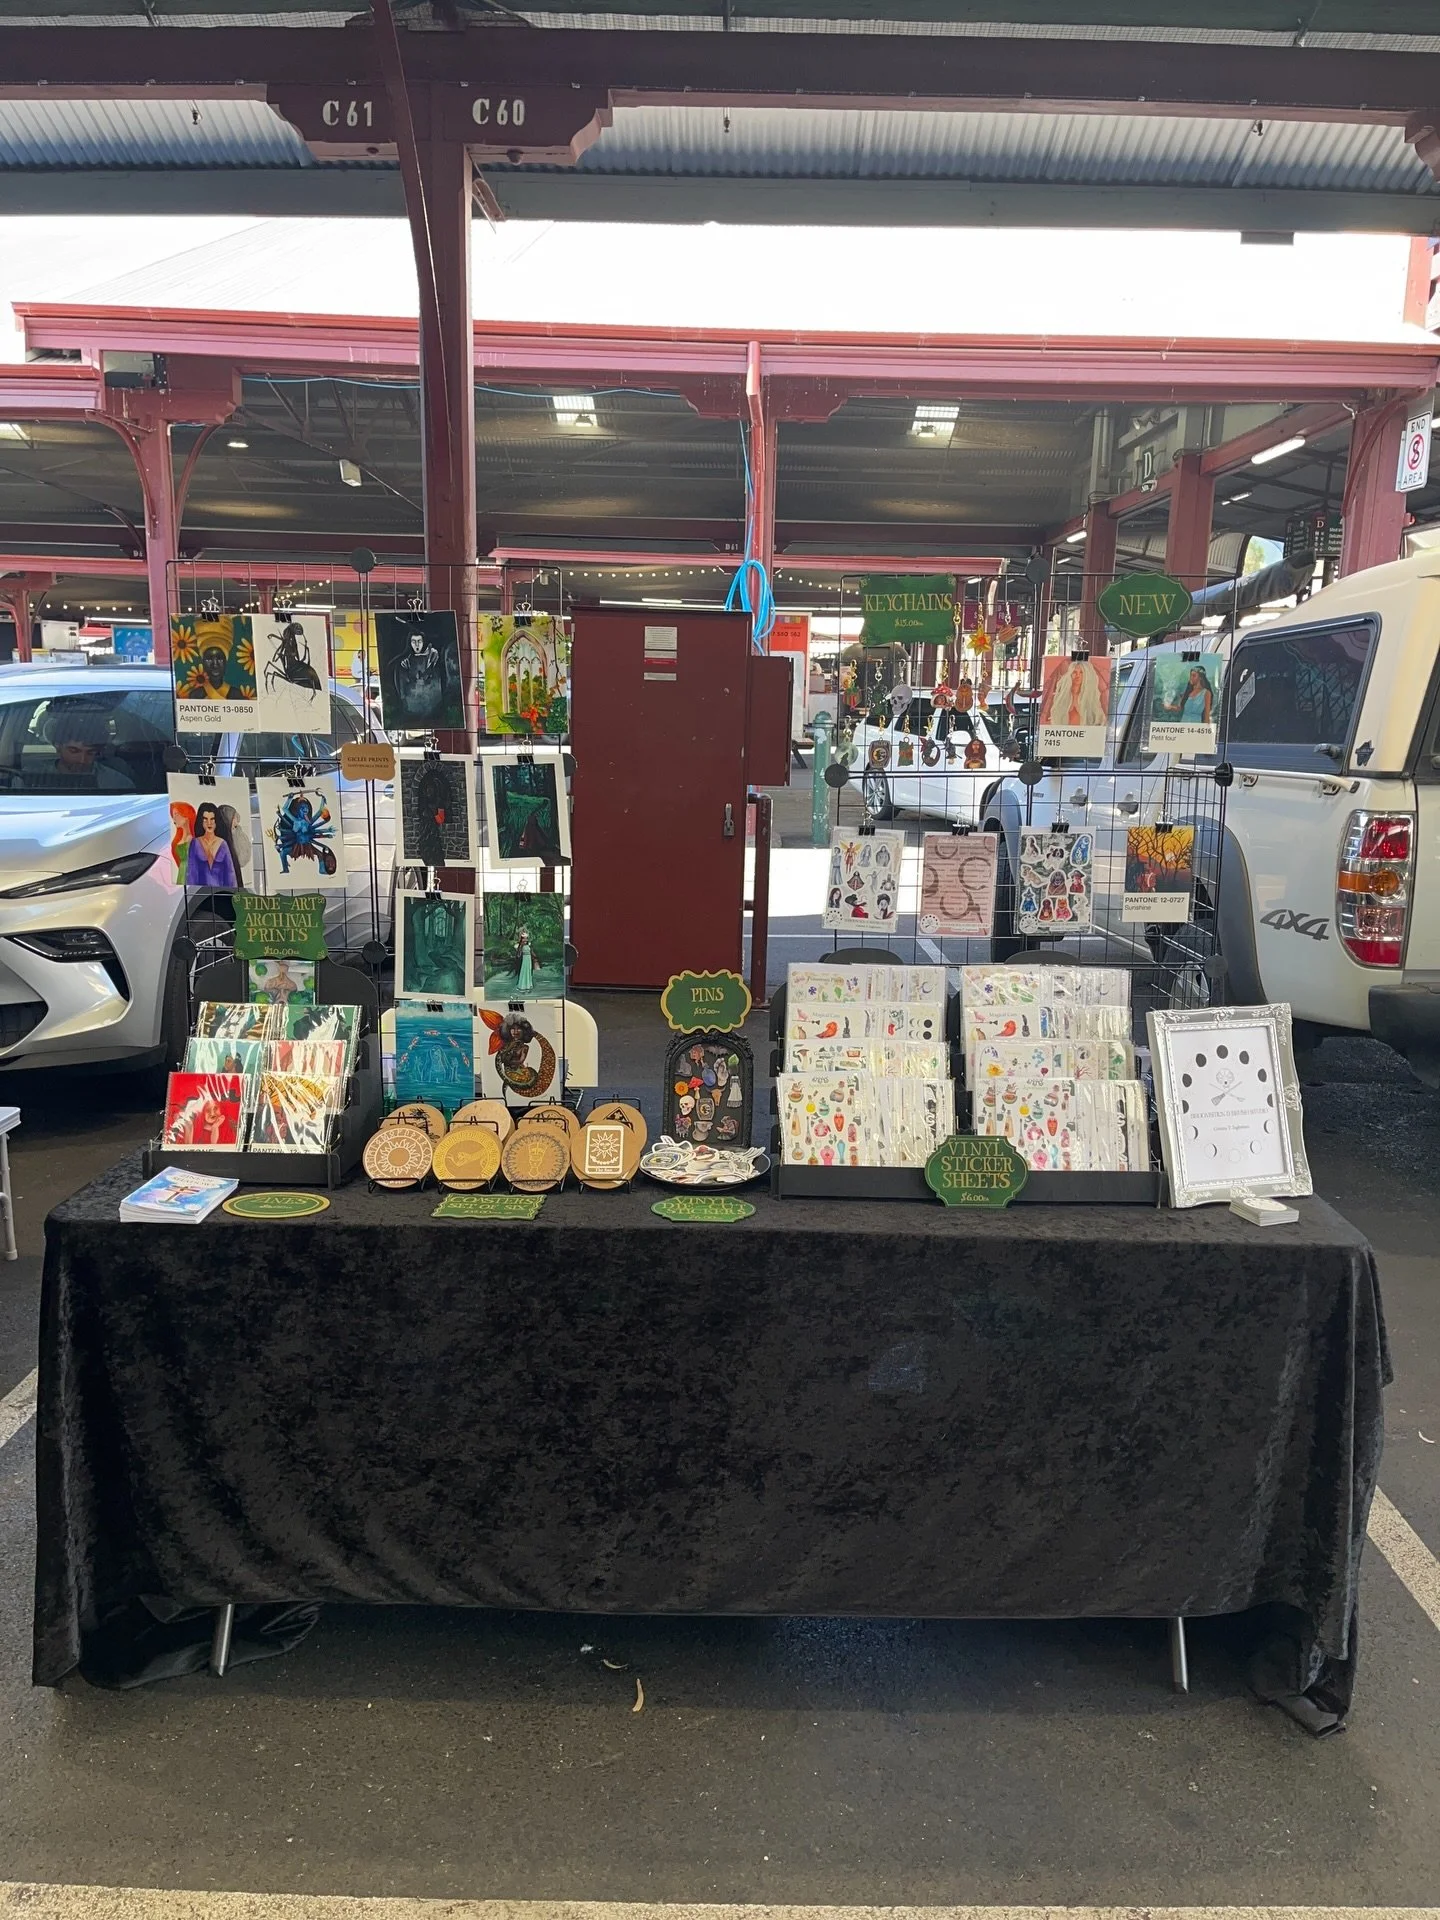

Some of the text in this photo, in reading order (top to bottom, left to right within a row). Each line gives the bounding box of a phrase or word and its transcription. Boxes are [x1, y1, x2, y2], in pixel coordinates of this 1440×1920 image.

[322, 100, 372, 127] C 61
[472, 98, 525, 126] C 60
[1411, 418, 1426, 433] END
[1403, 472, 1423, 485] AREA
[863, 593, 953, 612] KEYCHAINS
[1119, 593, 1177, 616] NEW
[179, 705, 254, 714] PANTONE 13-0850
[179, 715, 222, 723] Aspen Gold
[1044, 729, 1085, 738] PANTONE
[1186, 727, 1212, 735] 14-4516
[1044, 739, 1061, 747] 7415
[243, 913, 319, 928] ARCHIVAL
[246, 927, 309, 943] PRINTS
[690, 987, 725, 1003] PINS
[948, 1141, 1004, 1157] VINYL
[941, 1155, 1015, 1173] STICKER
[942, 1172, 1011, 1189] SHEETS
[252, 1196, 307, 1205] ZINES
[451, 1196, 536, 1204] COASTERS
[675, 1197, 727, 1205] VINYL
